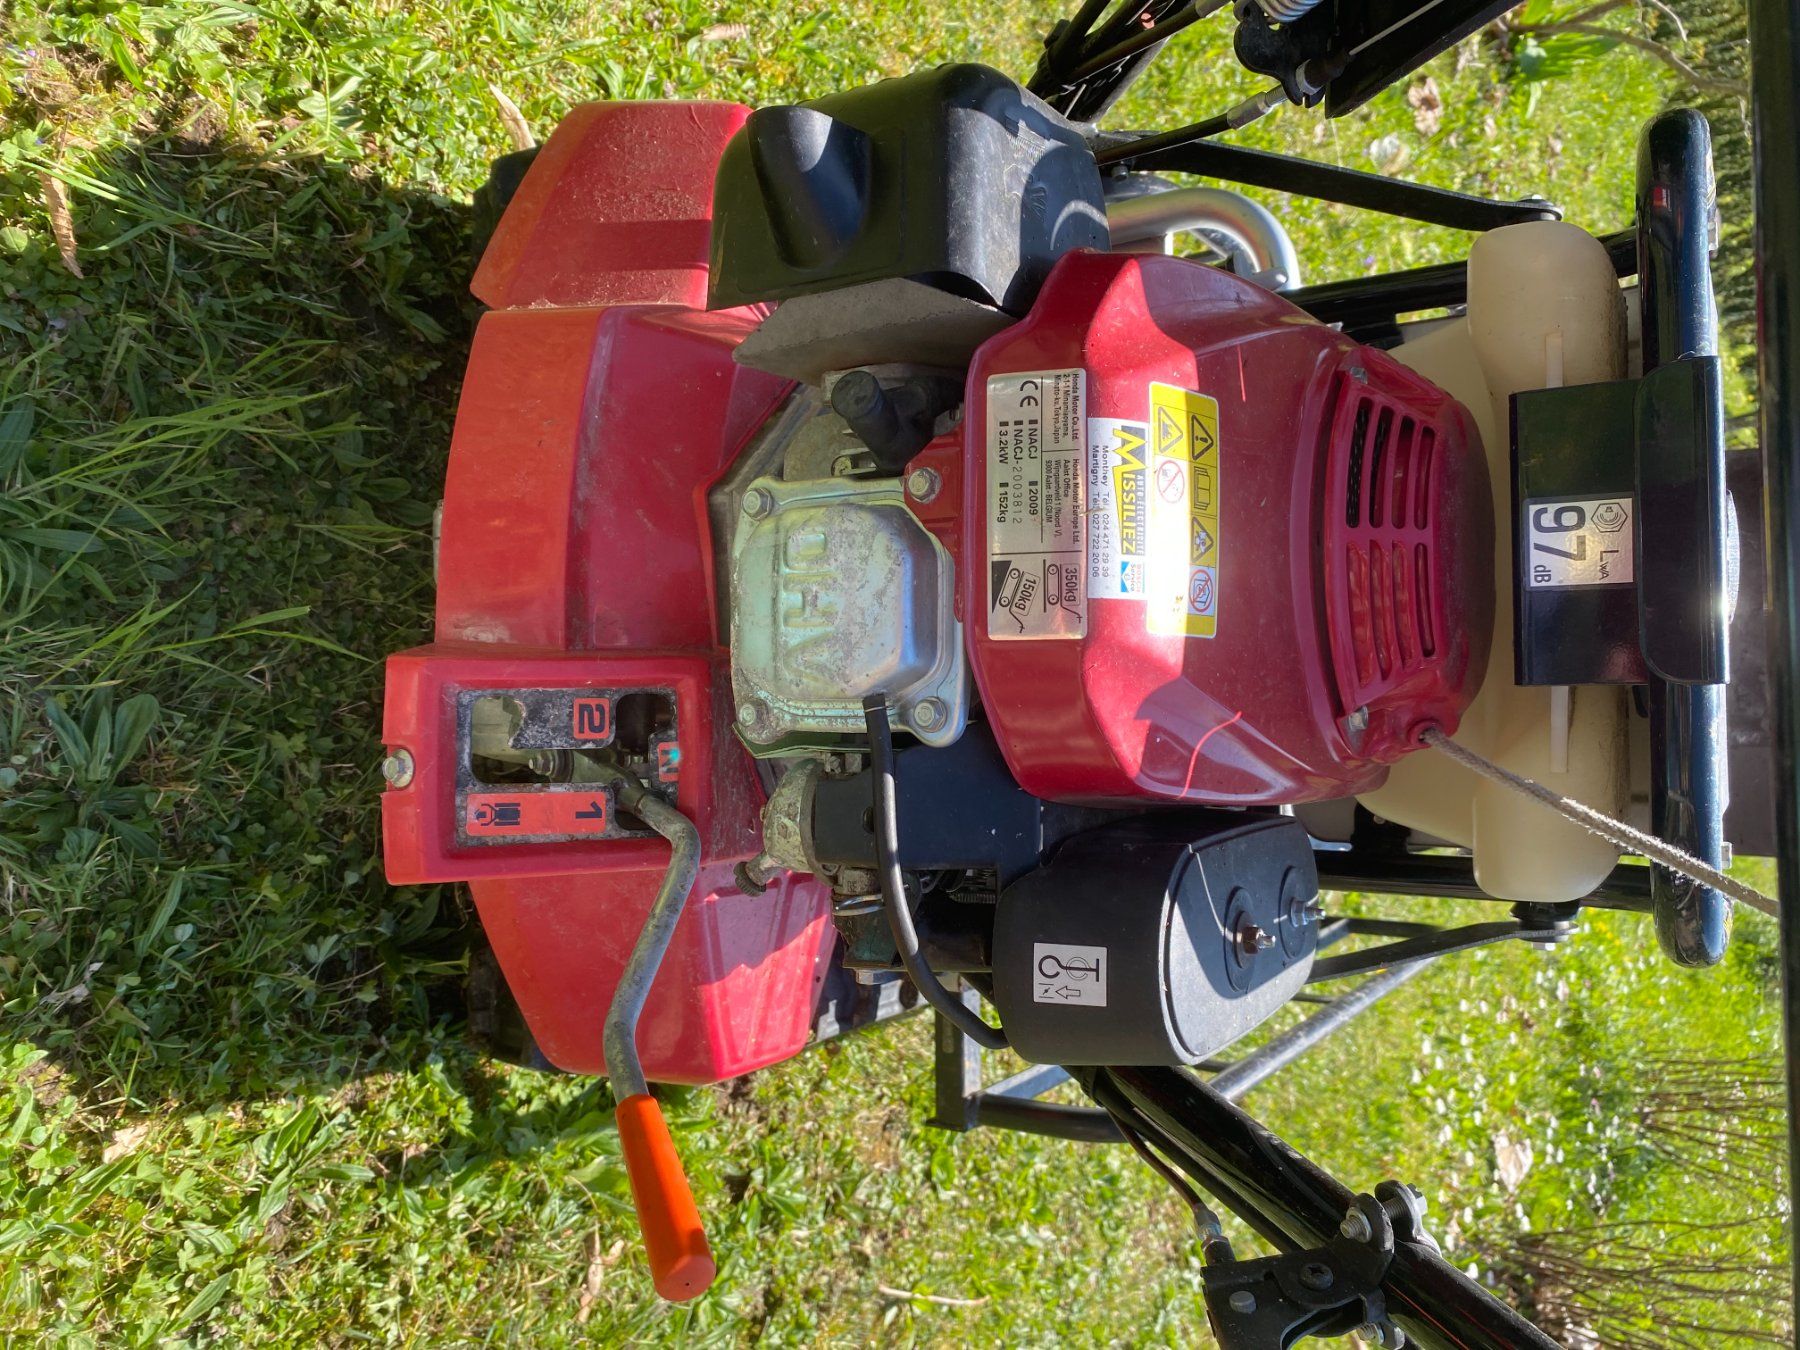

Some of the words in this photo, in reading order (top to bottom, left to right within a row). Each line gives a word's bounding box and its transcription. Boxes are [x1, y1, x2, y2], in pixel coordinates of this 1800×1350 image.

[1020, 380, 1039, 408] CE
[1072, 373, 1080, 394] Honda
[1072, 395, 1080, 415] Motor
[999, 429, 1009, 465] 3.2kW
[1028, 427, 1038, 460] NACJ
[1045, 459, 1053, 474] 9300
[1063, 459, 1071, 476] Aalst
[1072, 458, 1080, 480] Honda
[1091, 445, 1100, 487] Martigny
[1100, 445, 1110, 487] Monthey
[1012, 429, 1023, 525] NACJ-2003812
[1045, 474, 1053, 490] Aalst
[1063, 477, 1071, 498] Office
[1028, 488, 1038, 516] 2009
[1072, 482, 1080, 503] Motor
[997, 491, 1009, 523] 152kg
[1045, 494, 1053, 523] BELGIUM
[1071, 505, 1080, 529] Europe
[1092, 513, 1100, 530] 027
[1102, 513, 1110, 531] 024
[1072, 530, 1080, 544] Ltd.
[1092, 533, 1100, 550] 722
[1102, 532, 1110, 549] 471
[1532, 505, 1587, 562] 97
[1092, 552, 1100, 564] 20
[1102, 552, 1110, 564] 29
[1092, 566, 1100, 578] 06
[1102, 566, 1110, 578] 39
[1533, 564, 1552, 584] dB
[1014, 578, 1036, 611] 150kg
[1064, 567, 1078, 603] 350kg
[578, 703, 606, 734] 2
[575, 800, 603, 819] 1
